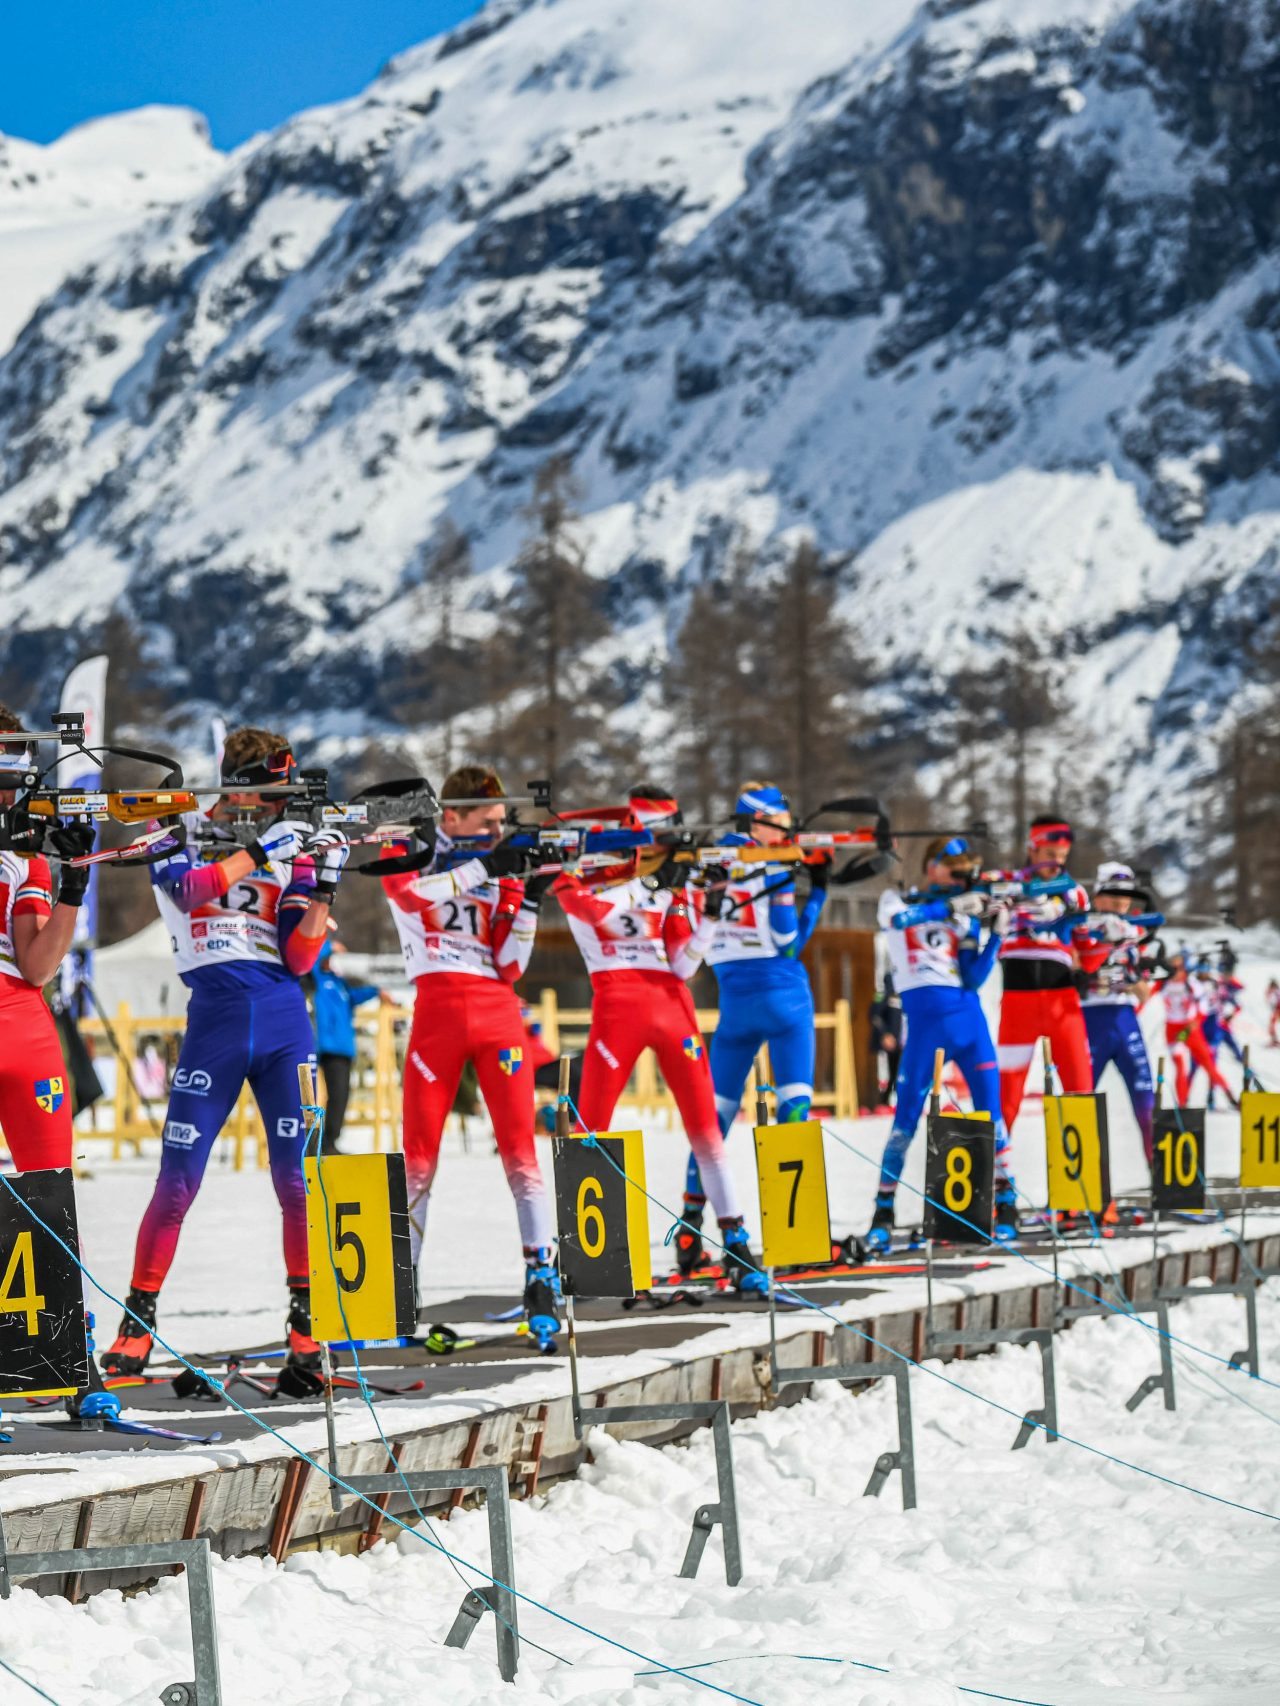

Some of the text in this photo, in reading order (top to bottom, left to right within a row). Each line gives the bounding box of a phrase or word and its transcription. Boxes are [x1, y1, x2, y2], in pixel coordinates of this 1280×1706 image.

[443, 900, 478, 936] 21
[621, 915, 638, 937] 3
[1062, 1124, 1083, 1181] 9
[1157, 1131, 1198, 1187] 10
[1252, 1116, 1280, 1163] 11
[778, 1159, 804, 1228] 7
[943, 1146, 973, 1212] 8
[576, 1176, 606, 1258] 6
[334, 1201, 366, 1294] 5
